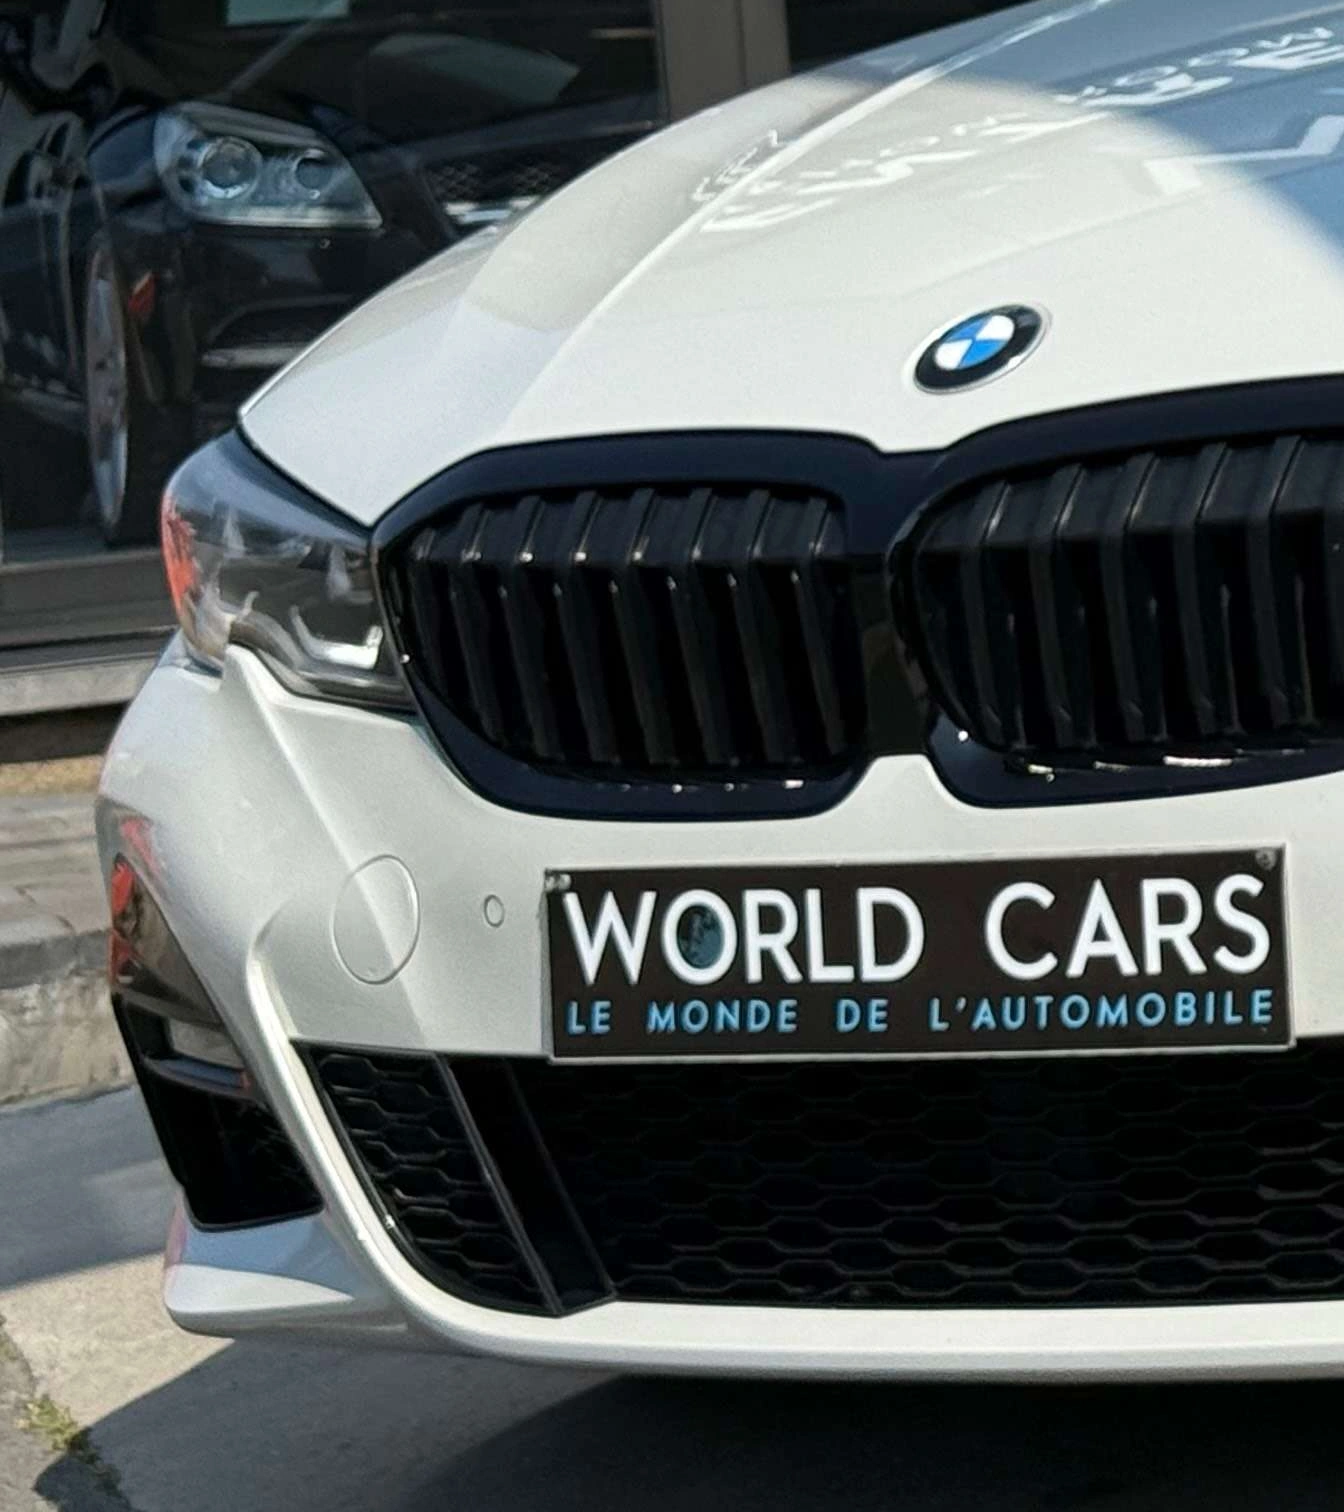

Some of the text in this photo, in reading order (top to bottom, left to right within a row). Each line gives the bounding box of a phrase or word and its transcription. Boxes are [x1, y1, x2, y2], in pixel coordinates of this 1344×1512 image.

[563, 873, 1272, 986] WORLD CARS
[566, 987, 1275, 1035] LE MONDE DE L'AUTOMOBILE
